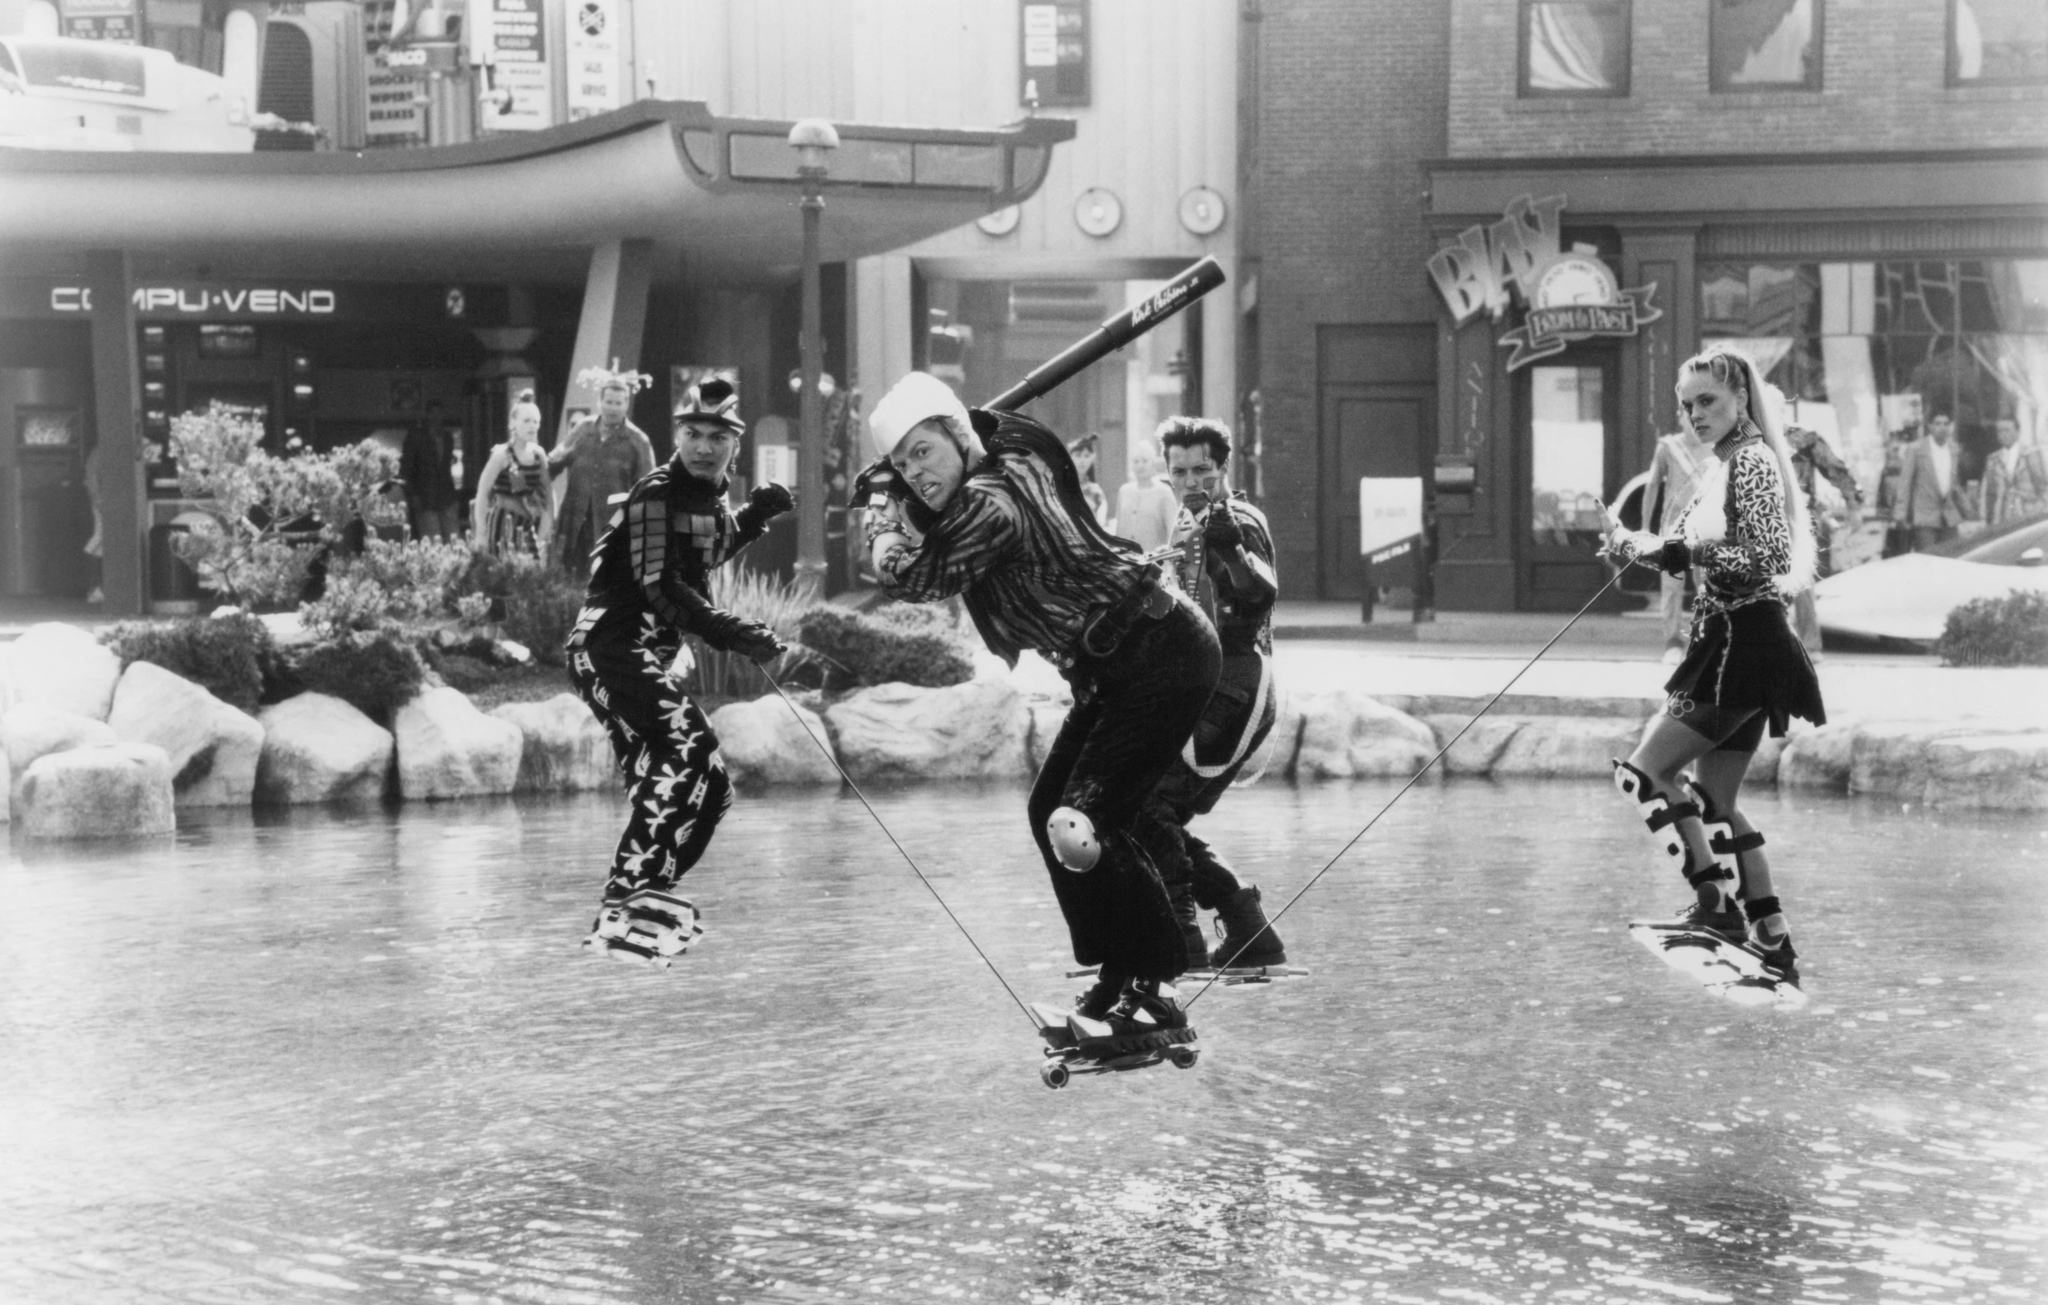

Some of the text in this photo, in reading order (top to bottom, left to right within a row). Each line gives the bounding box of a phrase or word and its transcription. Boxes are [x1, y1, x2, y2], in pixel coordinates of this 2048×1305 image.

[369, 91, 414, 103] WIPERS
[369, 109, 415, 121] BRAKES
[1426, 193, 1567, 325] BLAST
